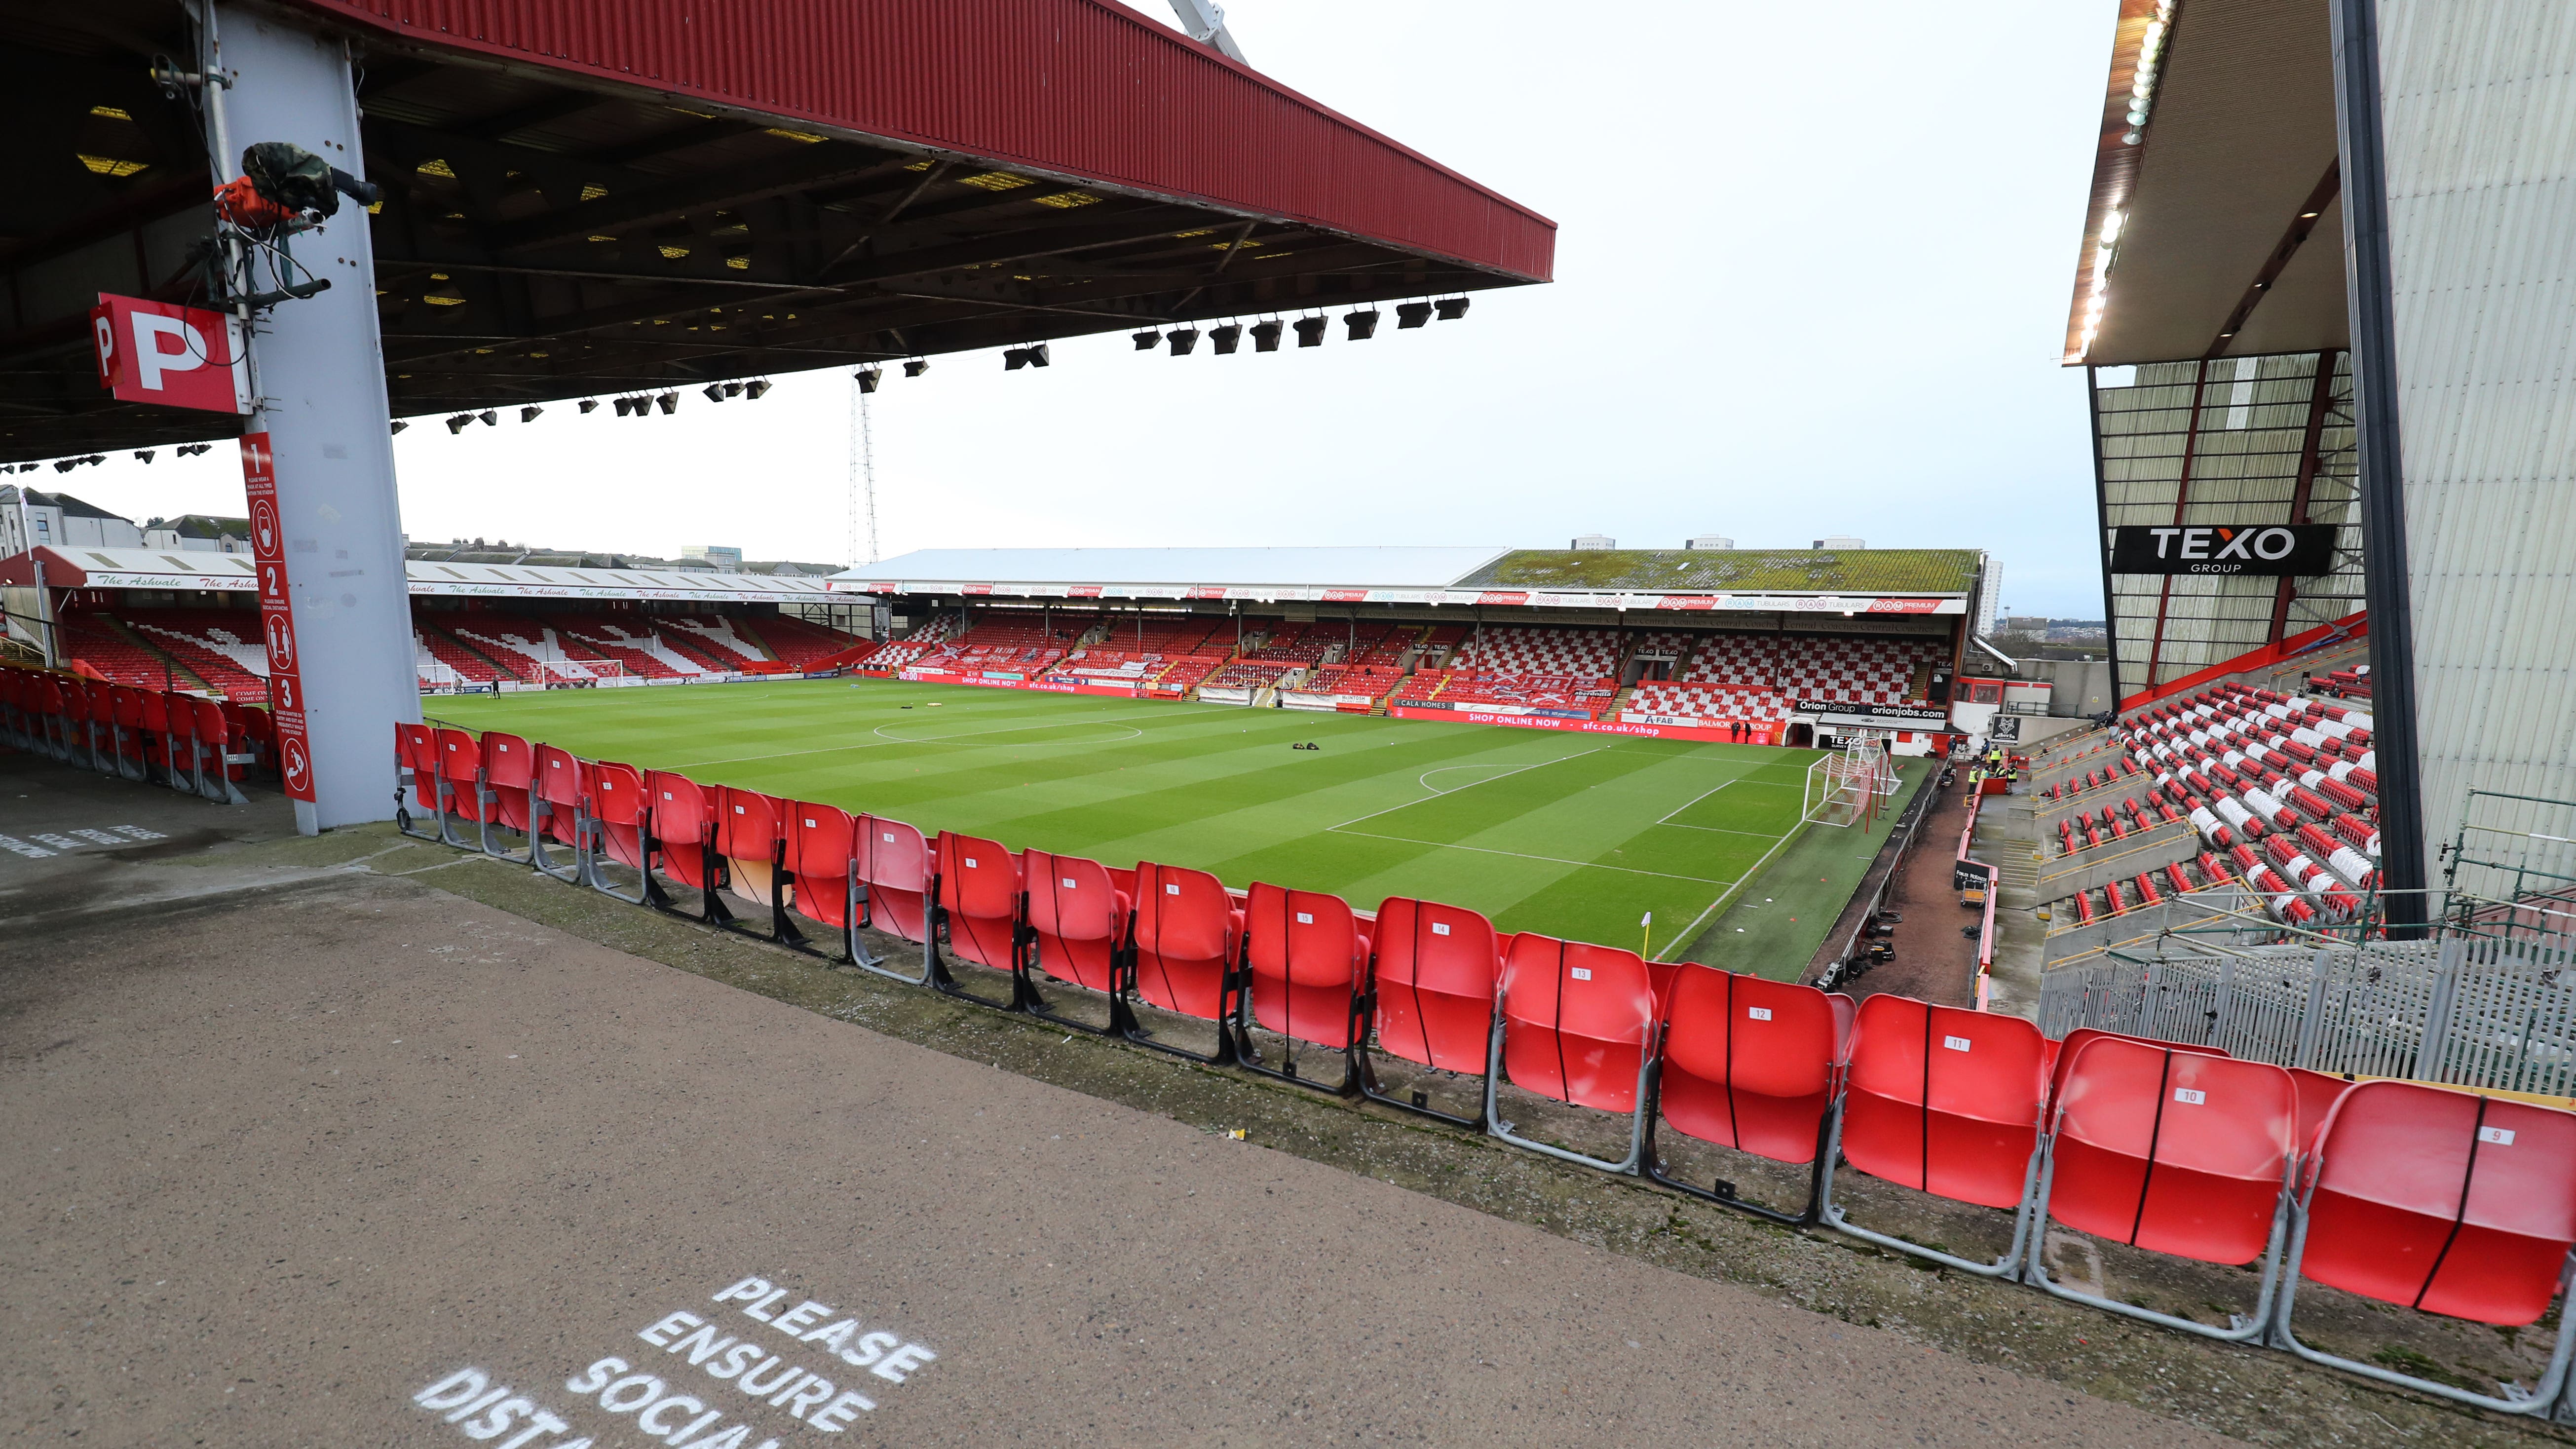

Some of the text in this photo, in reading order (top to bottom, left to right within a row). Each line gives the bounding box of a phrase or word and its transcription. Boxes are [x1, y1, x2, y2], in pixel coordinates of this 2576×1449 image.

[96, 316, 113, 377] P
[131, 311, 207, 391] P
[251, 444, 260, 474] 1
[2150, 528, 2295, 560] TEXO
[2191, 564, 2241, 572] GROUP
[98, 575, 182, 586] The Ashvale
[199, 578, 223, 587] The
[267, 567, 278, 595] 2
[470, 586, 504, 594] Ashvale
[1372, 592, 1394, 600] RAM
[1480, 594, 1503, 603] RAM
[1536, 595, 1560, 604] RAM
[1595, 596, 1622, 606] RAM
[1661, 597, 1688, 607] RAM
[1725, 598, 1754, 608] RAM
[1795, 599, 1826, 610] RAM
[1873, 601, 1904, 611] RAM
[1745, 620, 1779, 628] Coaches
[1784, 621, 1816, 629] Central
[1821, 622, 1858, 631] Coaches
[899, 671, 917, 681] 00:00
[1029, 683, 1074, 692] afc.co.uk/shop
[281, 679, 292, 708] 3
[1800, 701, 1944, 719] Orion Group orionjobs.com
[1469, 714, 1659, 736] SHOP ONLINE NOW afc.co.uk/shop
[1699, 720, 1731, 729] BALMOR
[1830, 736, 1862, 745] TEXO
[29, 833, 87, 849] SOCIAL
[1953, 1039, 1962, 1049] 11
[2185, 1091, 2197, 1101] 10
[2492, 1130, 2501, 1141] 9
[711, 1275, 937, 1383] PLEASE
[638, 1310, 876, 1433] ENSURE
[566, 1357, 781, 1449] SOCIA
